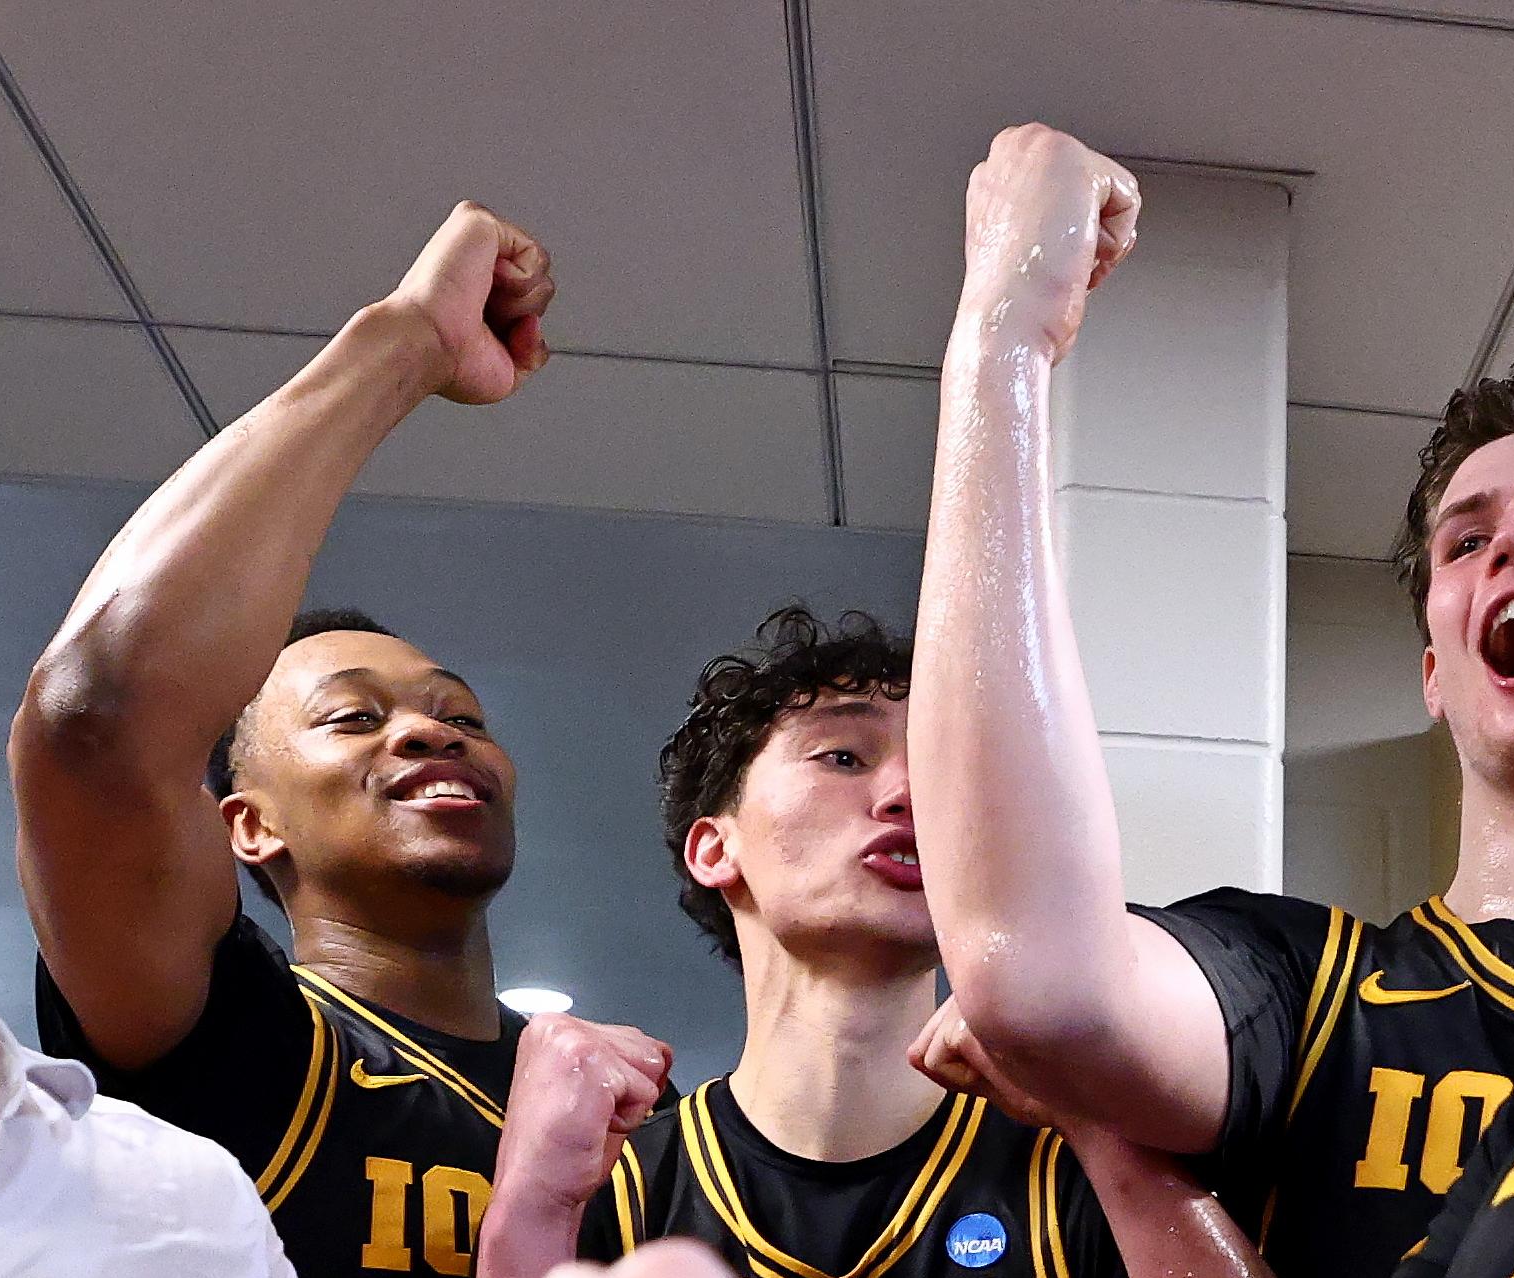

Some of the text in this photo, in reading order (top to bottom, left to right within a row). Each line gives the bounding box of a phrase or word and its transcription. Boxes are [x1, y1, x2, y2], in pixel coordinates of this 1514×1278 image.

[1354, 1066, 1514, 1195] IO
[361, 1156, 493, 1277] IO
[954, 1237, 1004, 1256] NCAA
